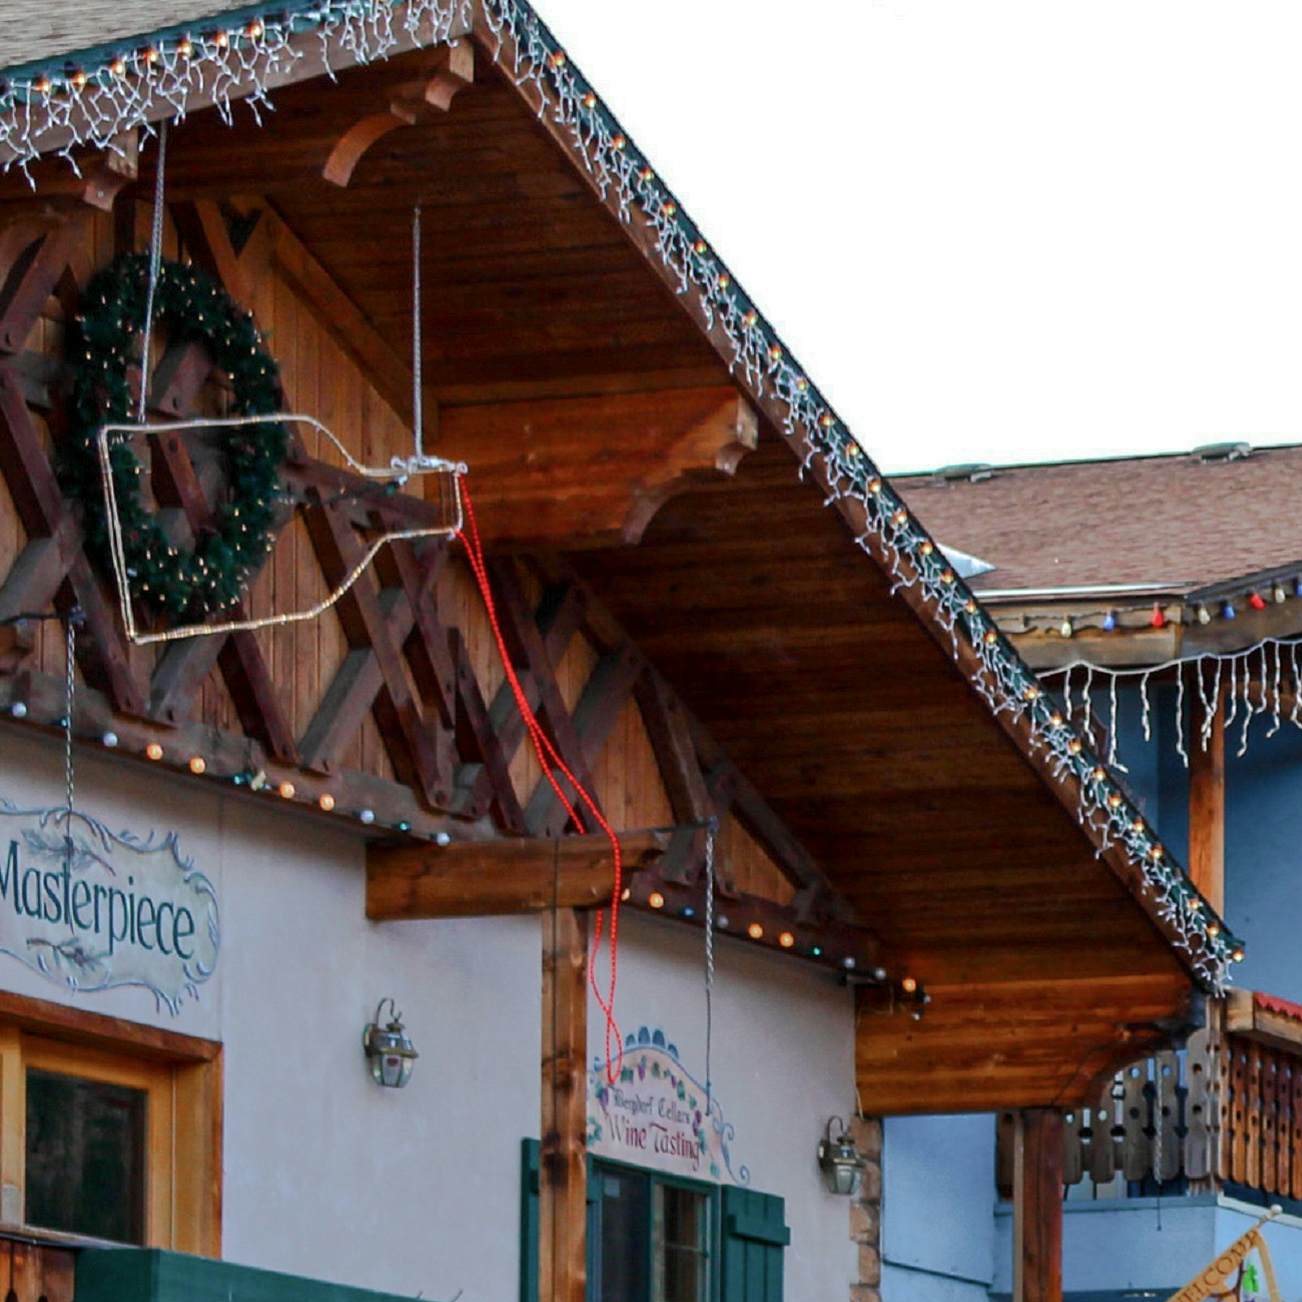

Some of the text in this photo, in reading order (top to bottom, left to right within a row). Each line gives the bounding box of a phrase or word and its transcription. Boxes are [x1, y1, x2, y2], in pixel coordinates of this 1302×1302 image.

[658, 1097, 691, 1125] Cellars
[606, 1114, 701, 1172] Wine Tasting
